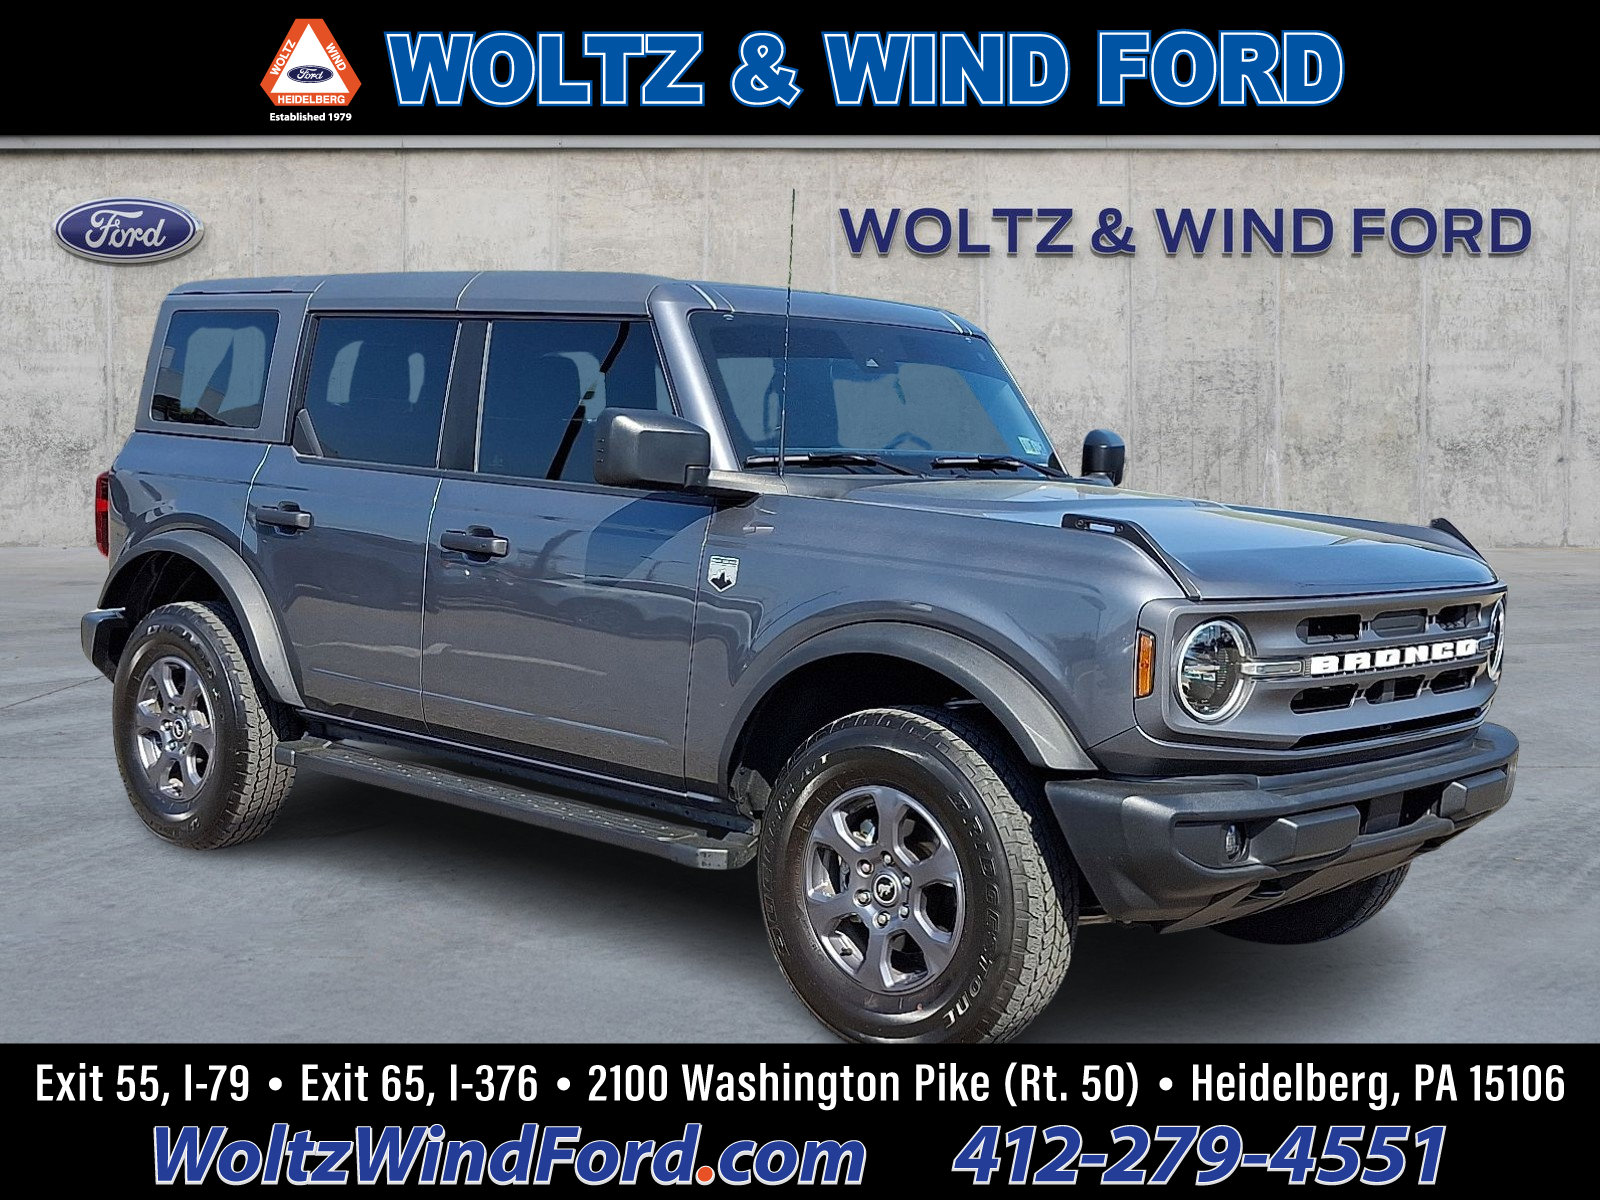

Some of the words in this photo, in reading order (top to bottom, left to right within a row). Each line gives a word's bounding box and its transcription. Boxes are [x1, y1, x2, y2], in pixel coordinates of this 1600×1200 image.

[85, 209, 167, 249] Ford
[840, 207, 1073, 254] WOLTZ
[1091, 207, 1137, 254] &
[1156, 207, 1333, 254] WIND
[1352, 207, 1533, 255] FORD
[1311, 638, 1478, 676] BRONCO
